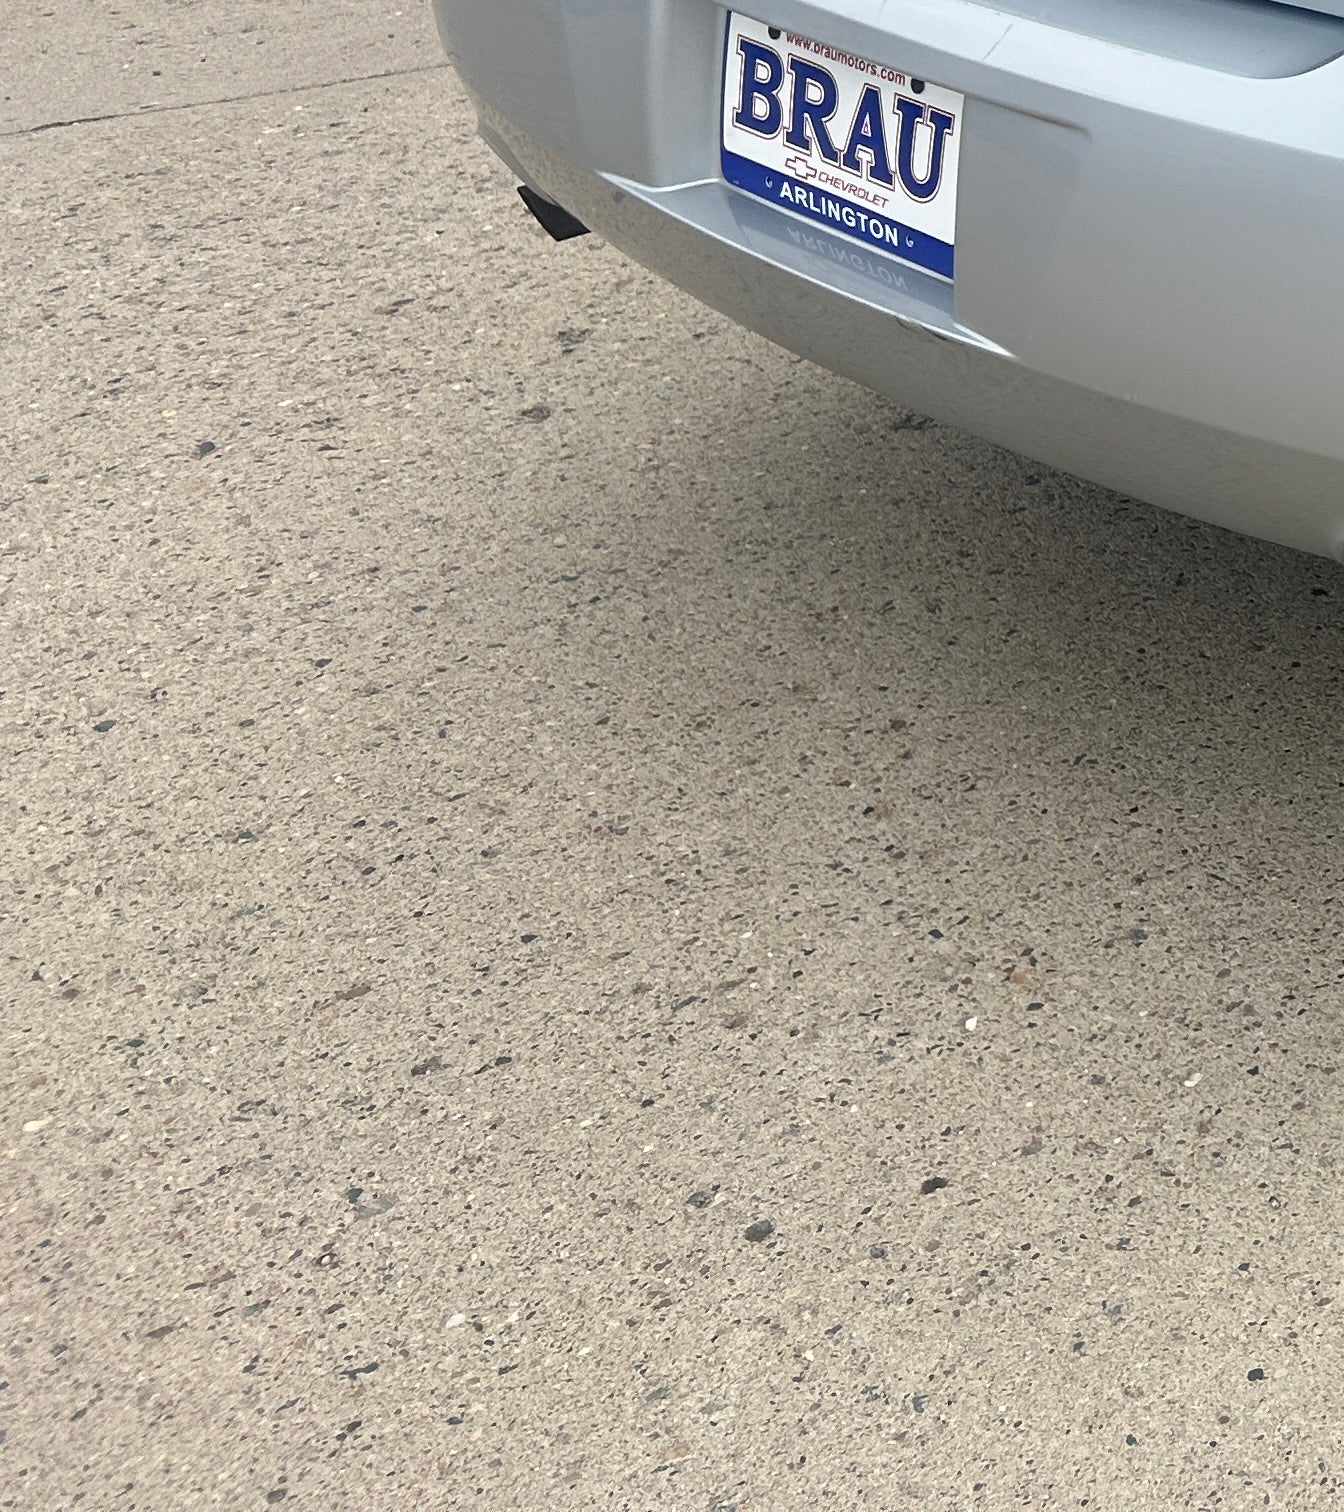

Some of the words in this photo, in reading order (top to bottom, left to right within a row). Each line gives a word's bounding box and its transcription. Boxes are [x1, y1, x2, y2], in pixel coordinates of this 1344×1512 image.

[732, 34, 955, 204] BRAU
[780, 181, 899, 247] ARLINGTON
[818, 171, 890, 208] CHEVROLET
